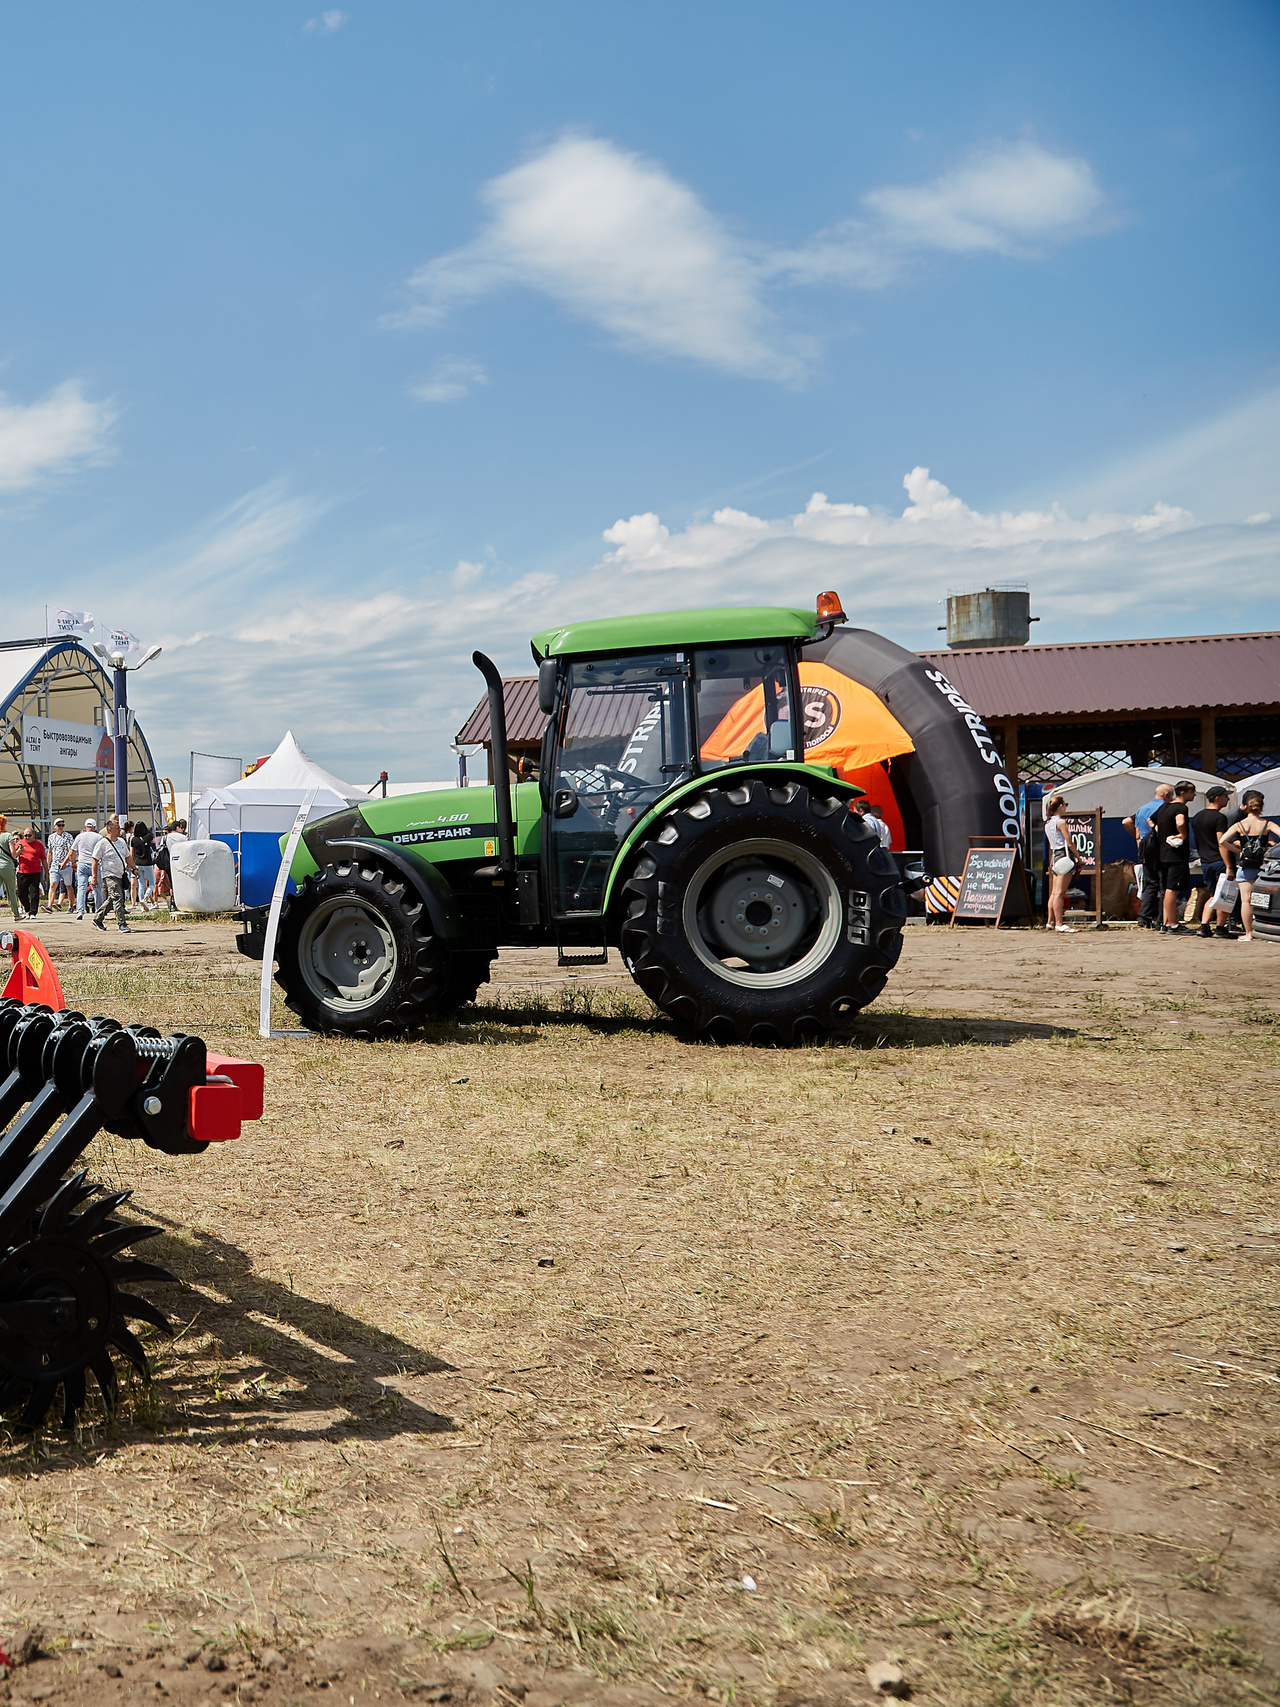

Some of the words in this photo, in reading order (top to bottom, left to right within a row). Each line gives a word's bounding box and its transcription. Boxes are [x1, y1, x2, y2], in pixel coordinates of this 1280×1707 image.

[924, 669, 1004, 769] STRIPES
[43, 729, 93, 745] Быстровозводимые
[59, 747, 78, 758] ангары
[437, 813, 470, 823] 4.80
[993, 773, 1023, 859] OOD
[392, 827, 472, 844] DEUTZ-FAHR
[975, 870, 1005, 883] жизнь
[967, 882, 978, 890] не
[848, 890, 871, 946] BKT
